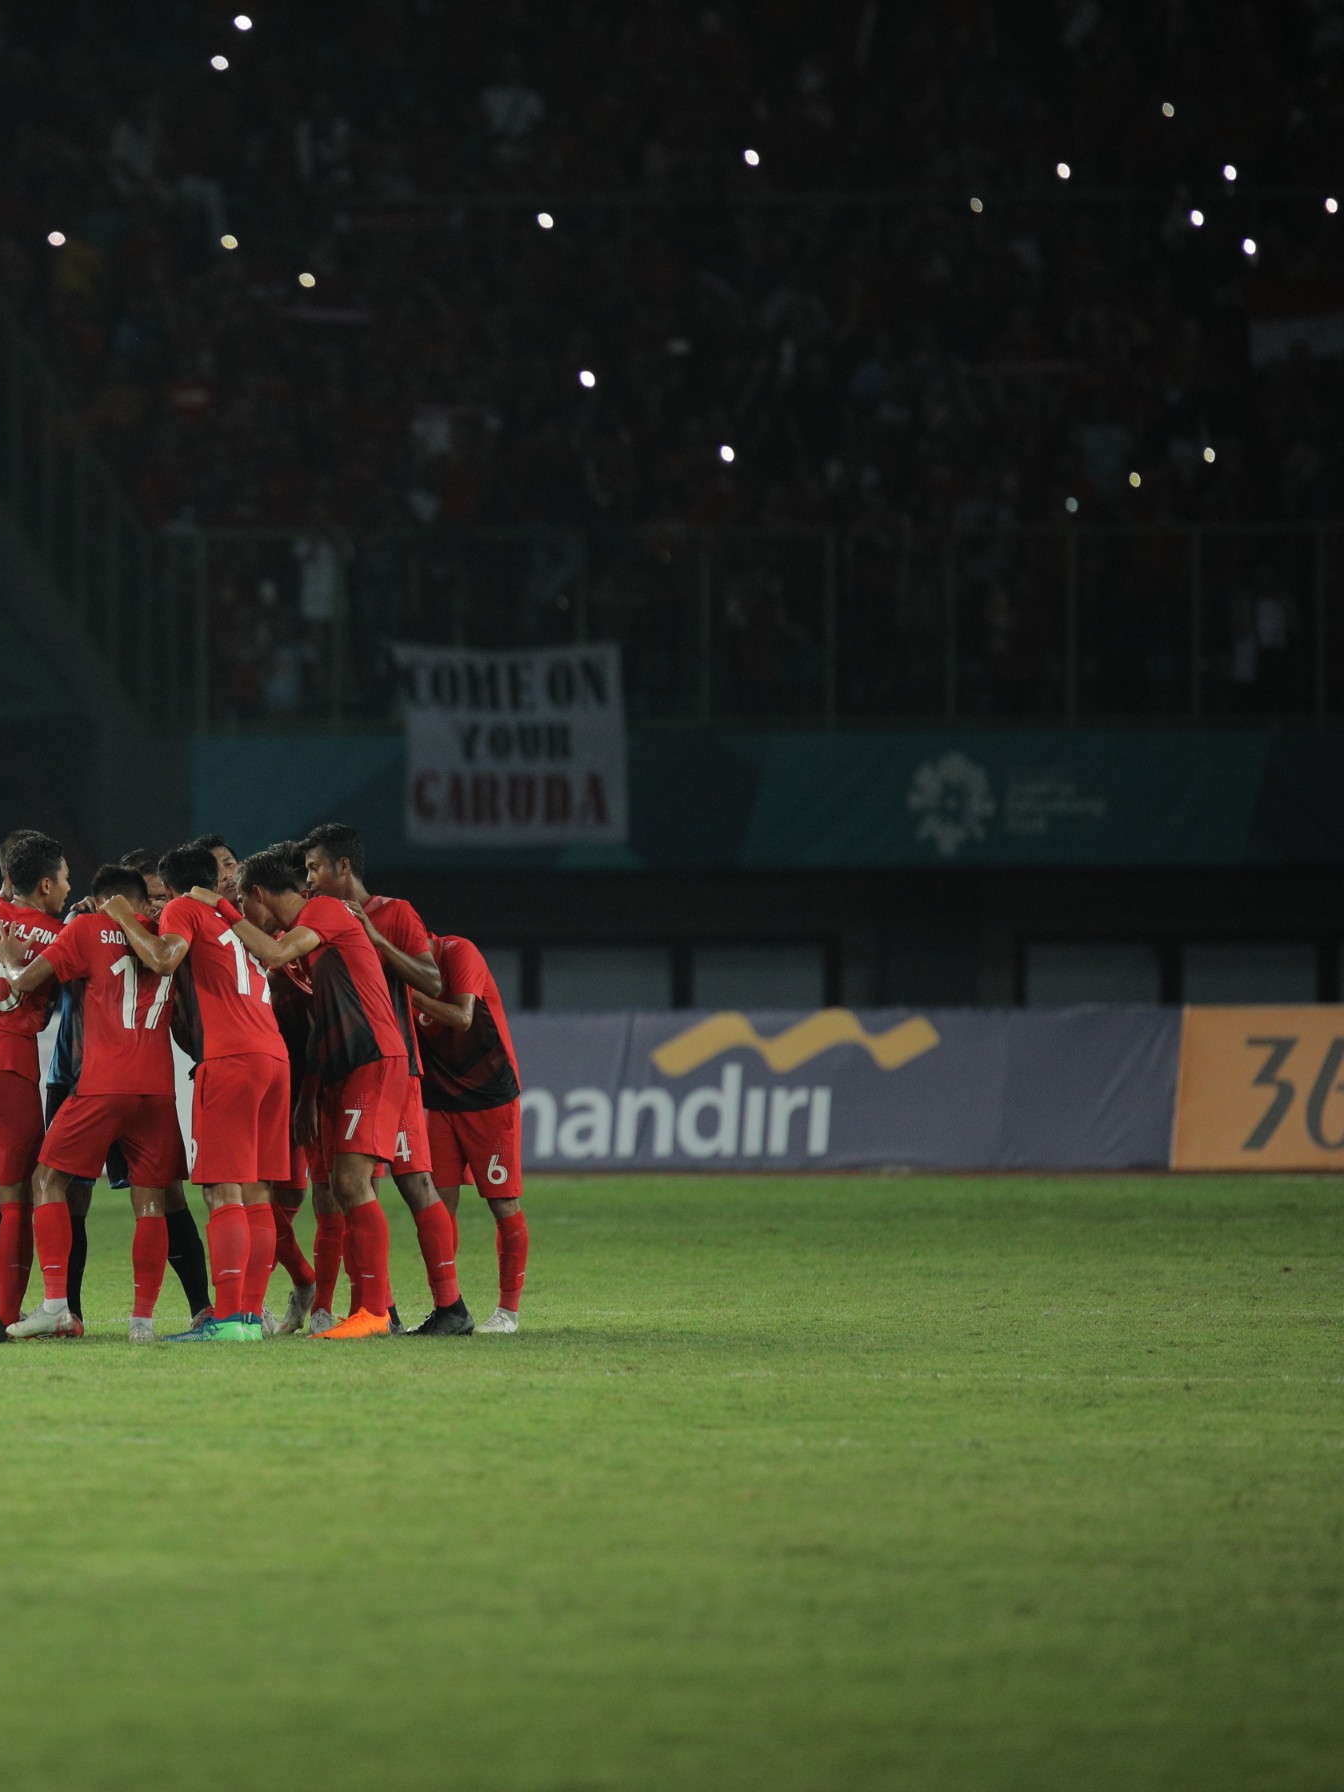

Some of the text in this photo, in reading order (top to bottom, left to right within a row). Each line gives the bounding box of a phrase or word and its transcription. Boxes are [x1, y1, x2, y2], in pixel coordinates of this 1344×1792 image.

[545, 656, 609, 708] ON
[459, 721, 571, 761] YOUR
[13, 923, 57, 944] AJRIN
[344, 1110, 362, 1140] 7
[395, 1131, 412, 1162] 4
[487, 1154, 508, 1185] 6
